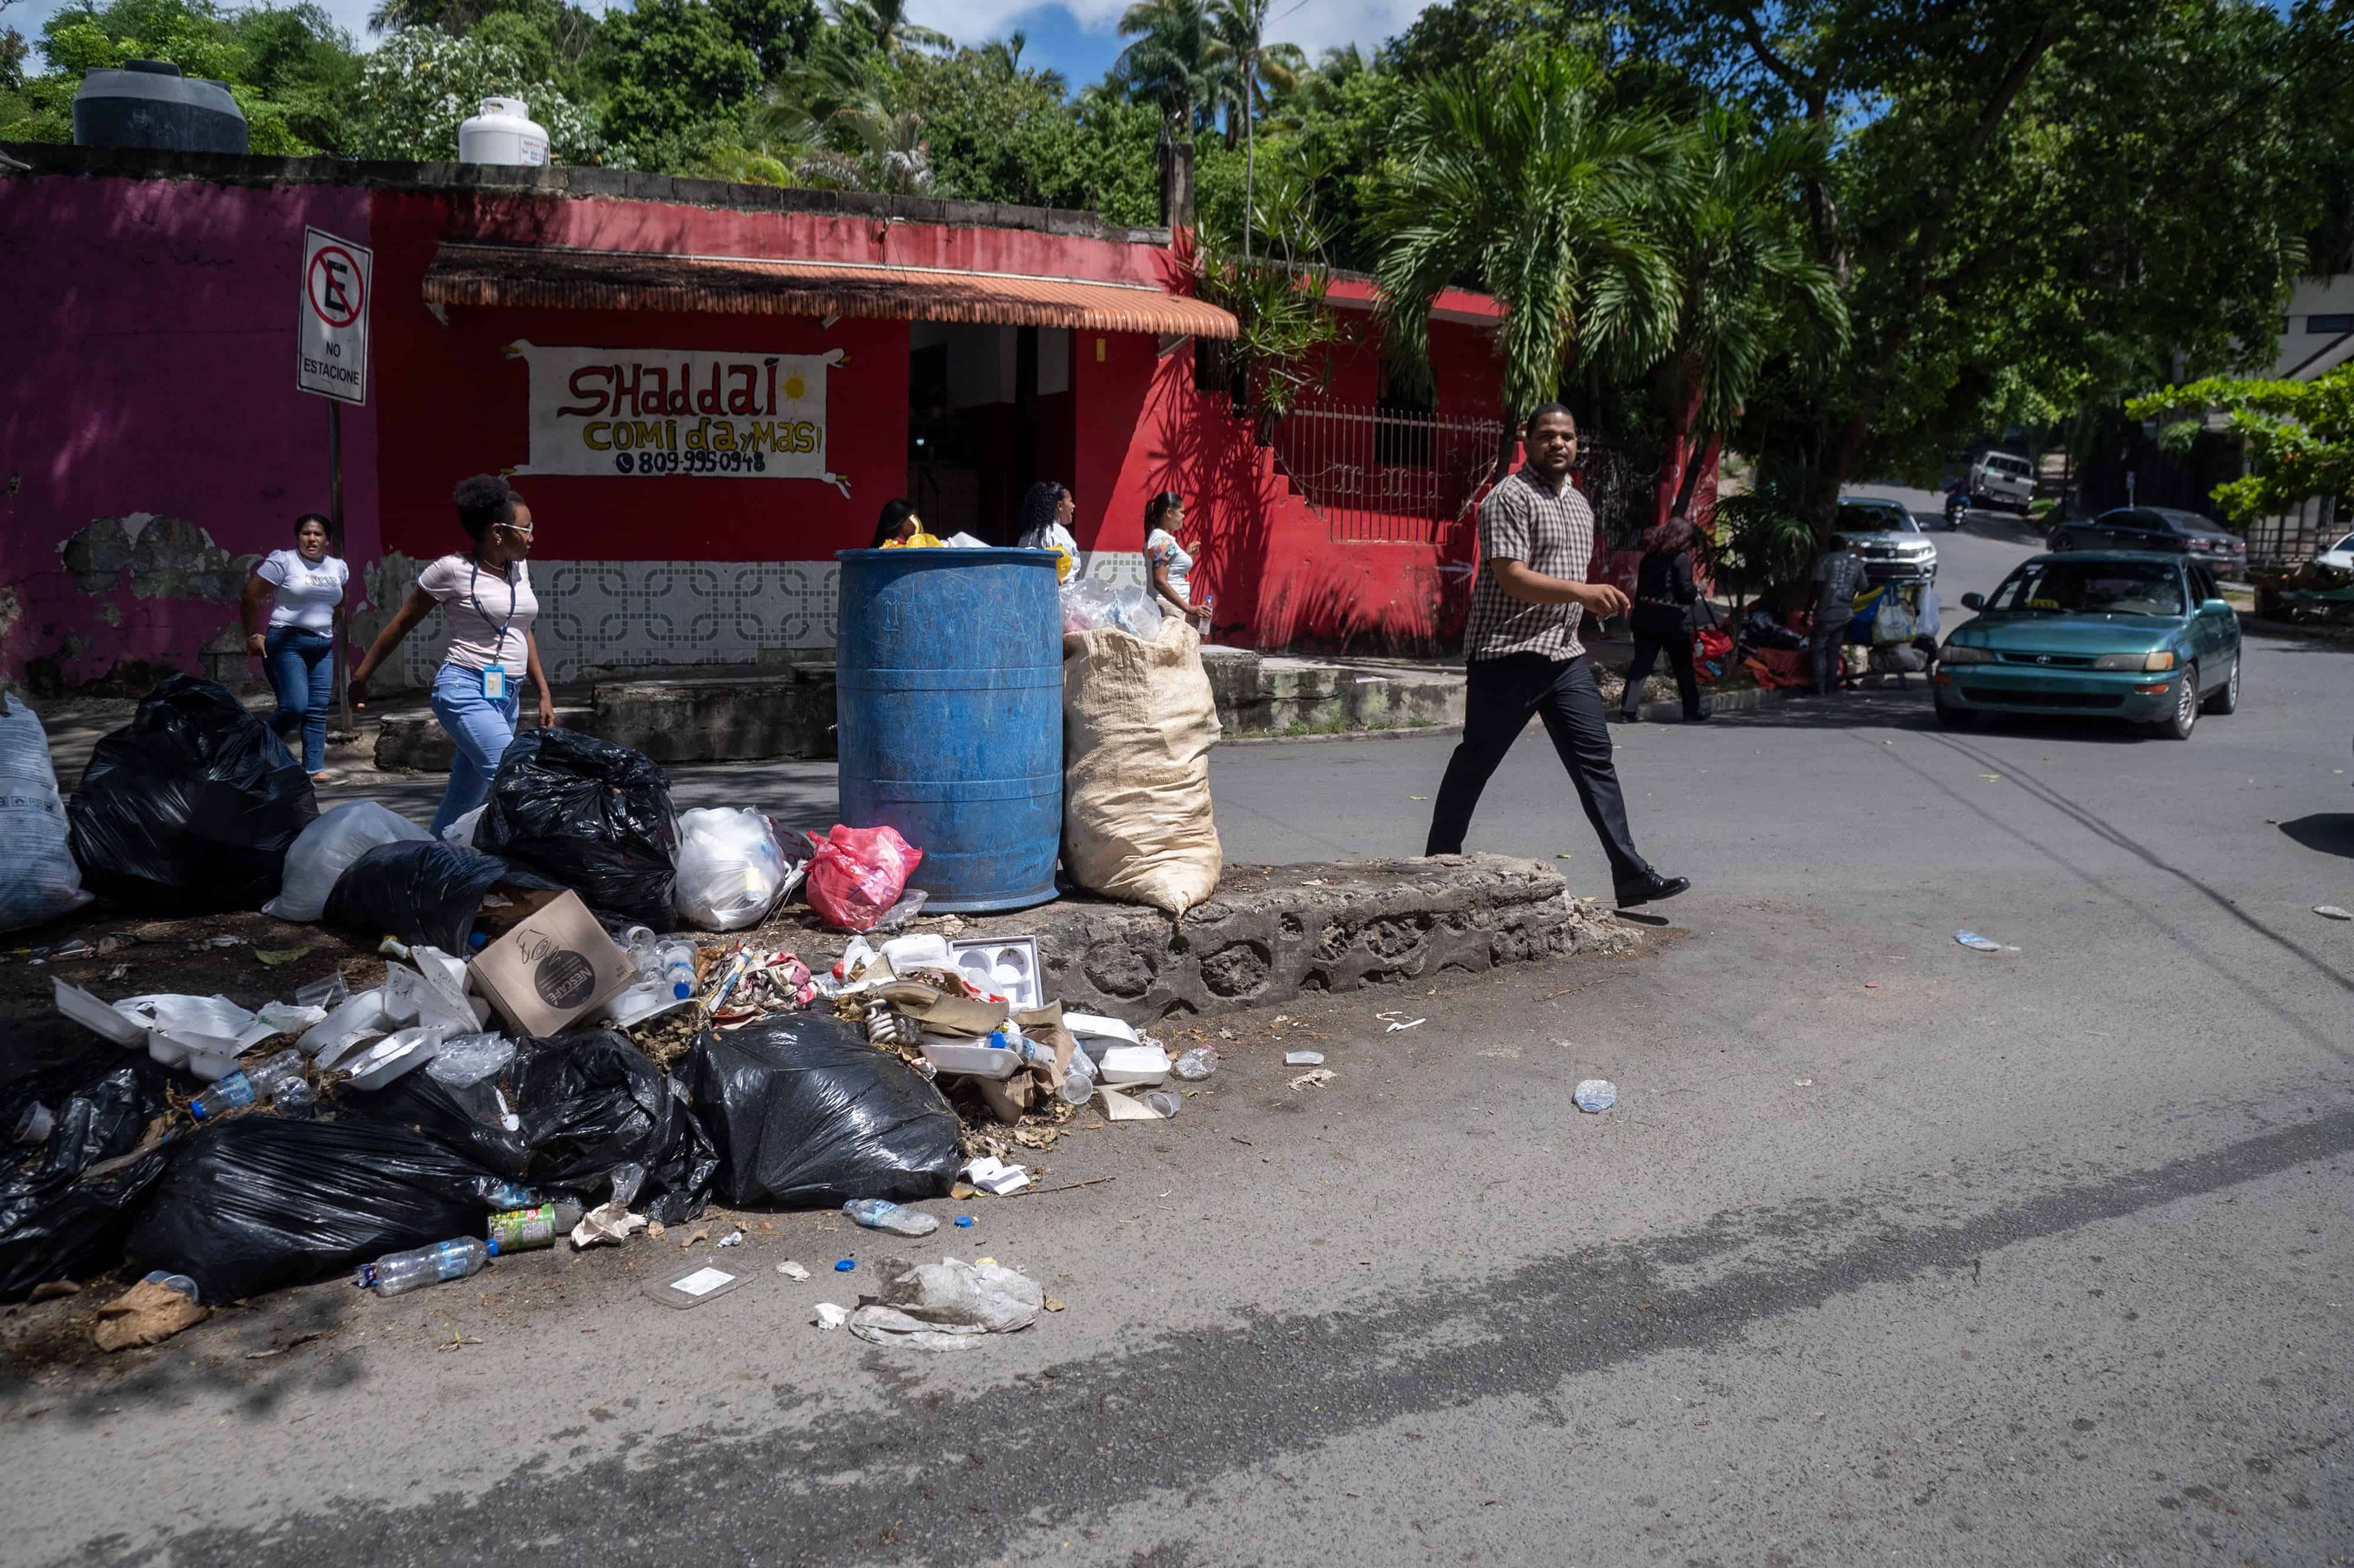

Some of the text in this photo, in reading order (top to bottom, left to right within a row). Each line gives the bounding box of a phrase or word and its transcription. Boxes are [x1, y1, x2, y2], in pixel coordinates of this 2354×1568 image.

[325, 259, 347, 313] E
[326, 342, 340, 357] NO
[304, 358, 359, 385] ESTACIONE
